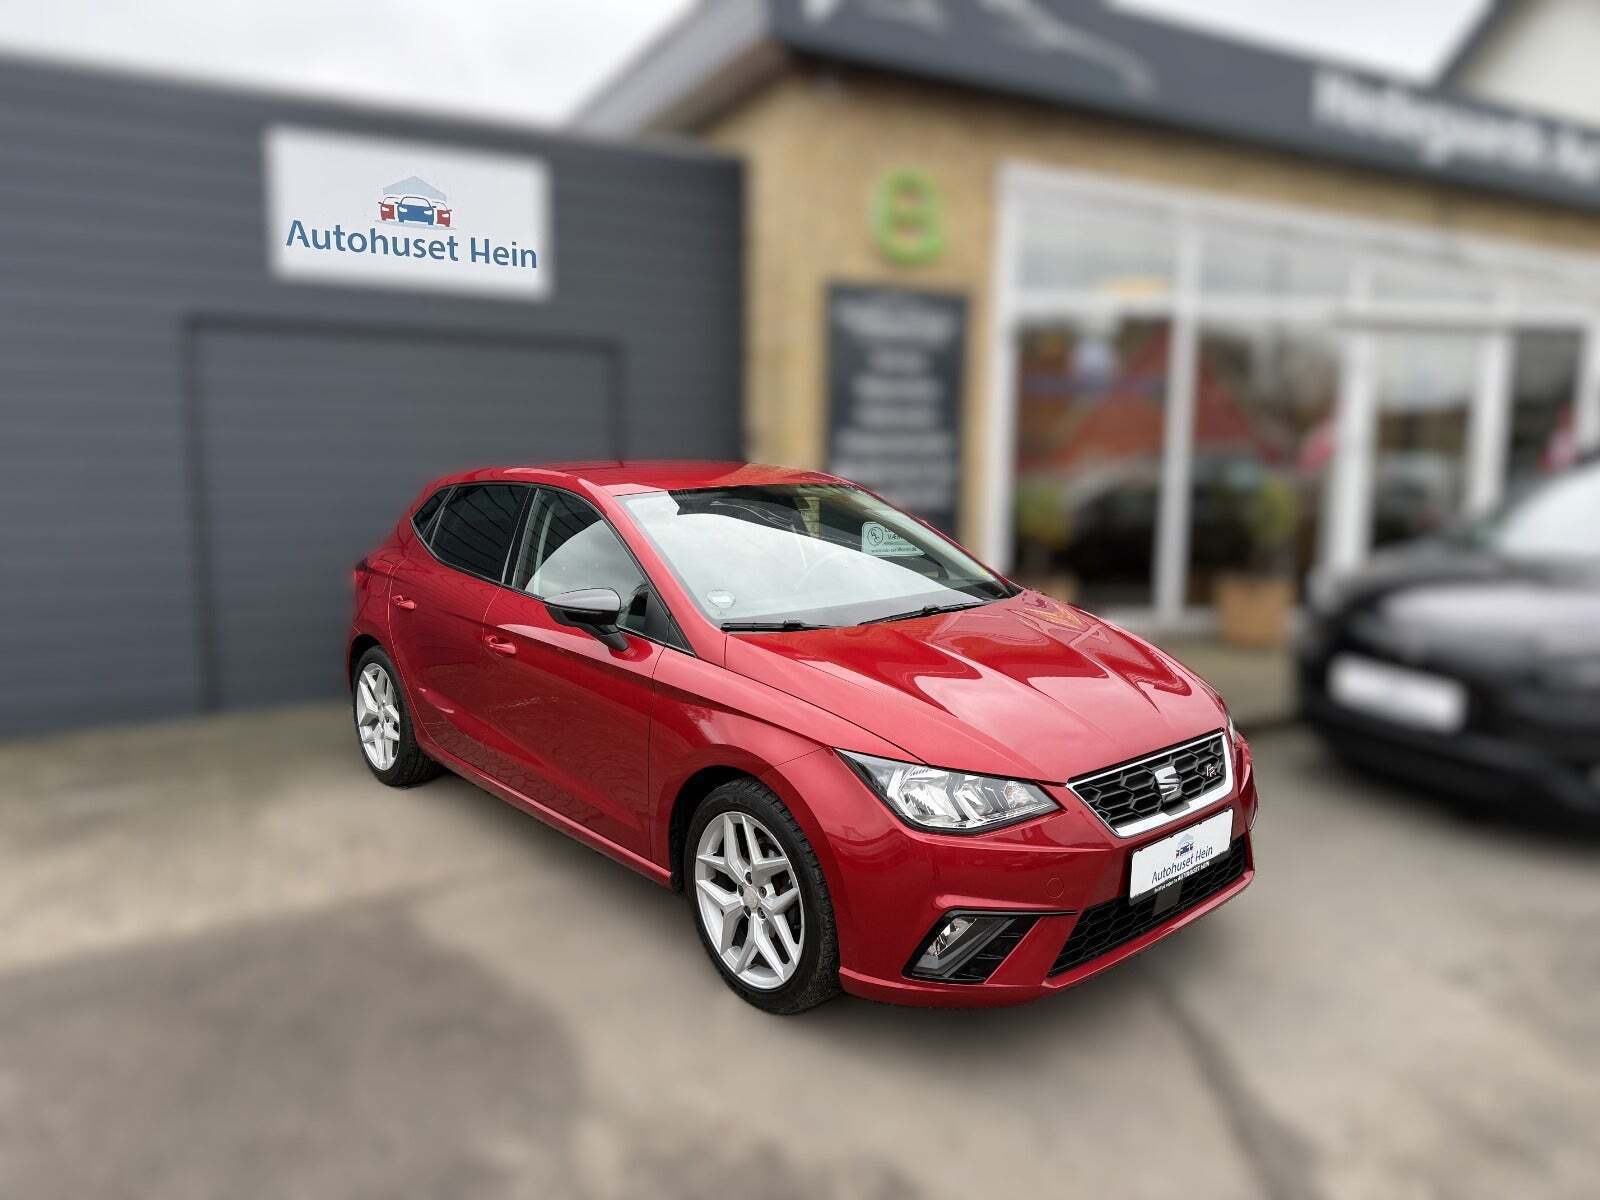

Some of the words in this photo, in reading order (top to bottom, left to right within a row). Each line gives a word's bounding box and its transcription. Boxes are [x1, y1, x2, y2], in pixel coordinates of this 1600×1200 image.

[286, 219, 458, 262] Autohuset
[470, 237, 537, 268] Hein
[1151, 853, 1194, 885] Autohuset
[1195, 846, 1213, 861] Hein
